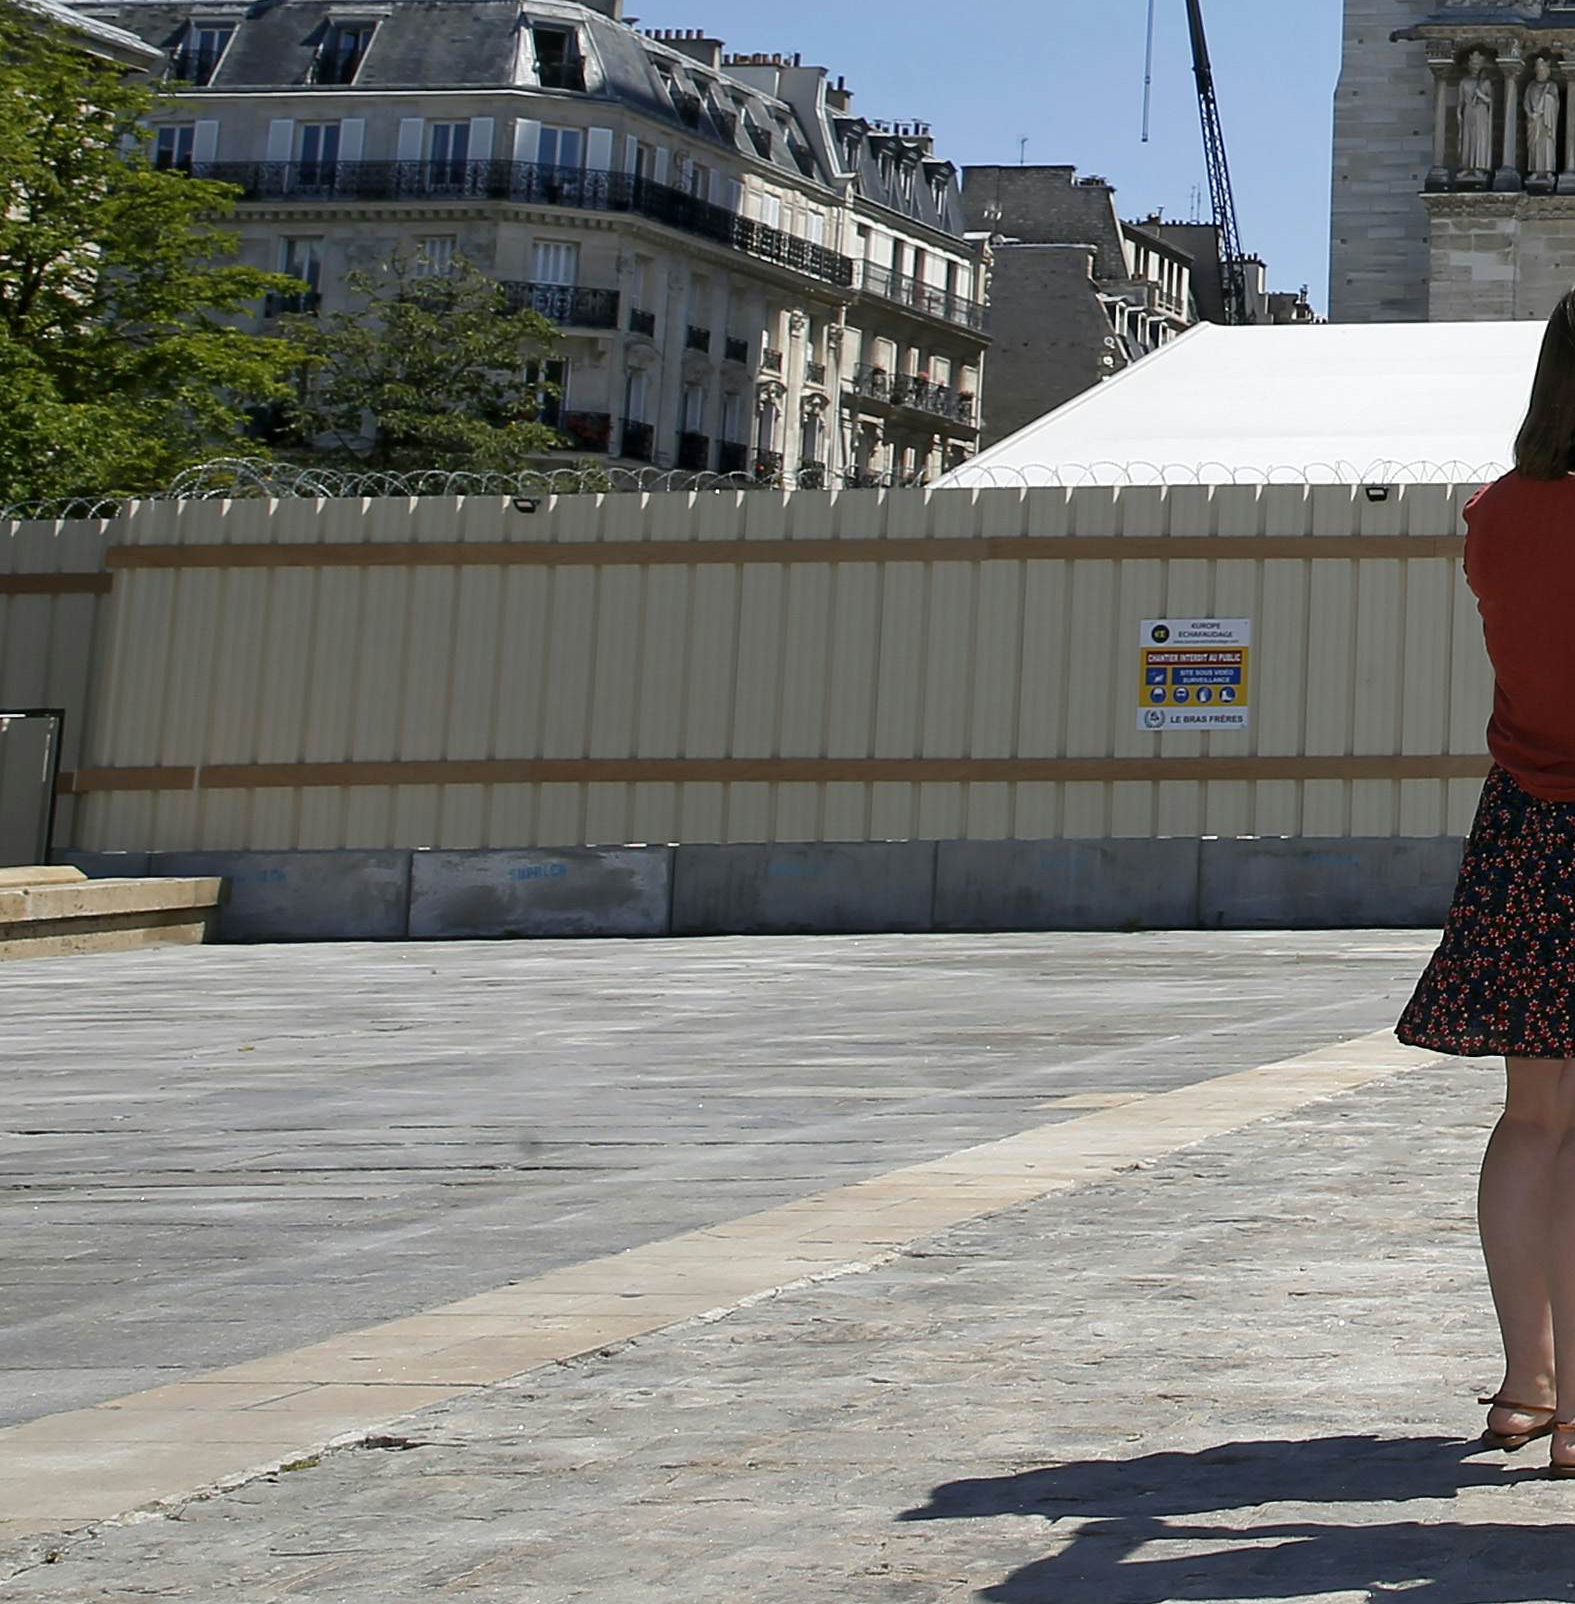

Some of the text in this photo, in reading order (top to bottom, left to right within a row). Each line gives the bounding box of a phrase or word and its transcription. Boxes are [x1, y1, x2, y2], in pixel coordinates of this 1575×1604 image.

[1148, 653, 1241, 662] CHANTIER INTERDIT AU PUBLIC
[1170, 716, 1182, 724] LE
[1183, 715, 1208, 723] BRAS
